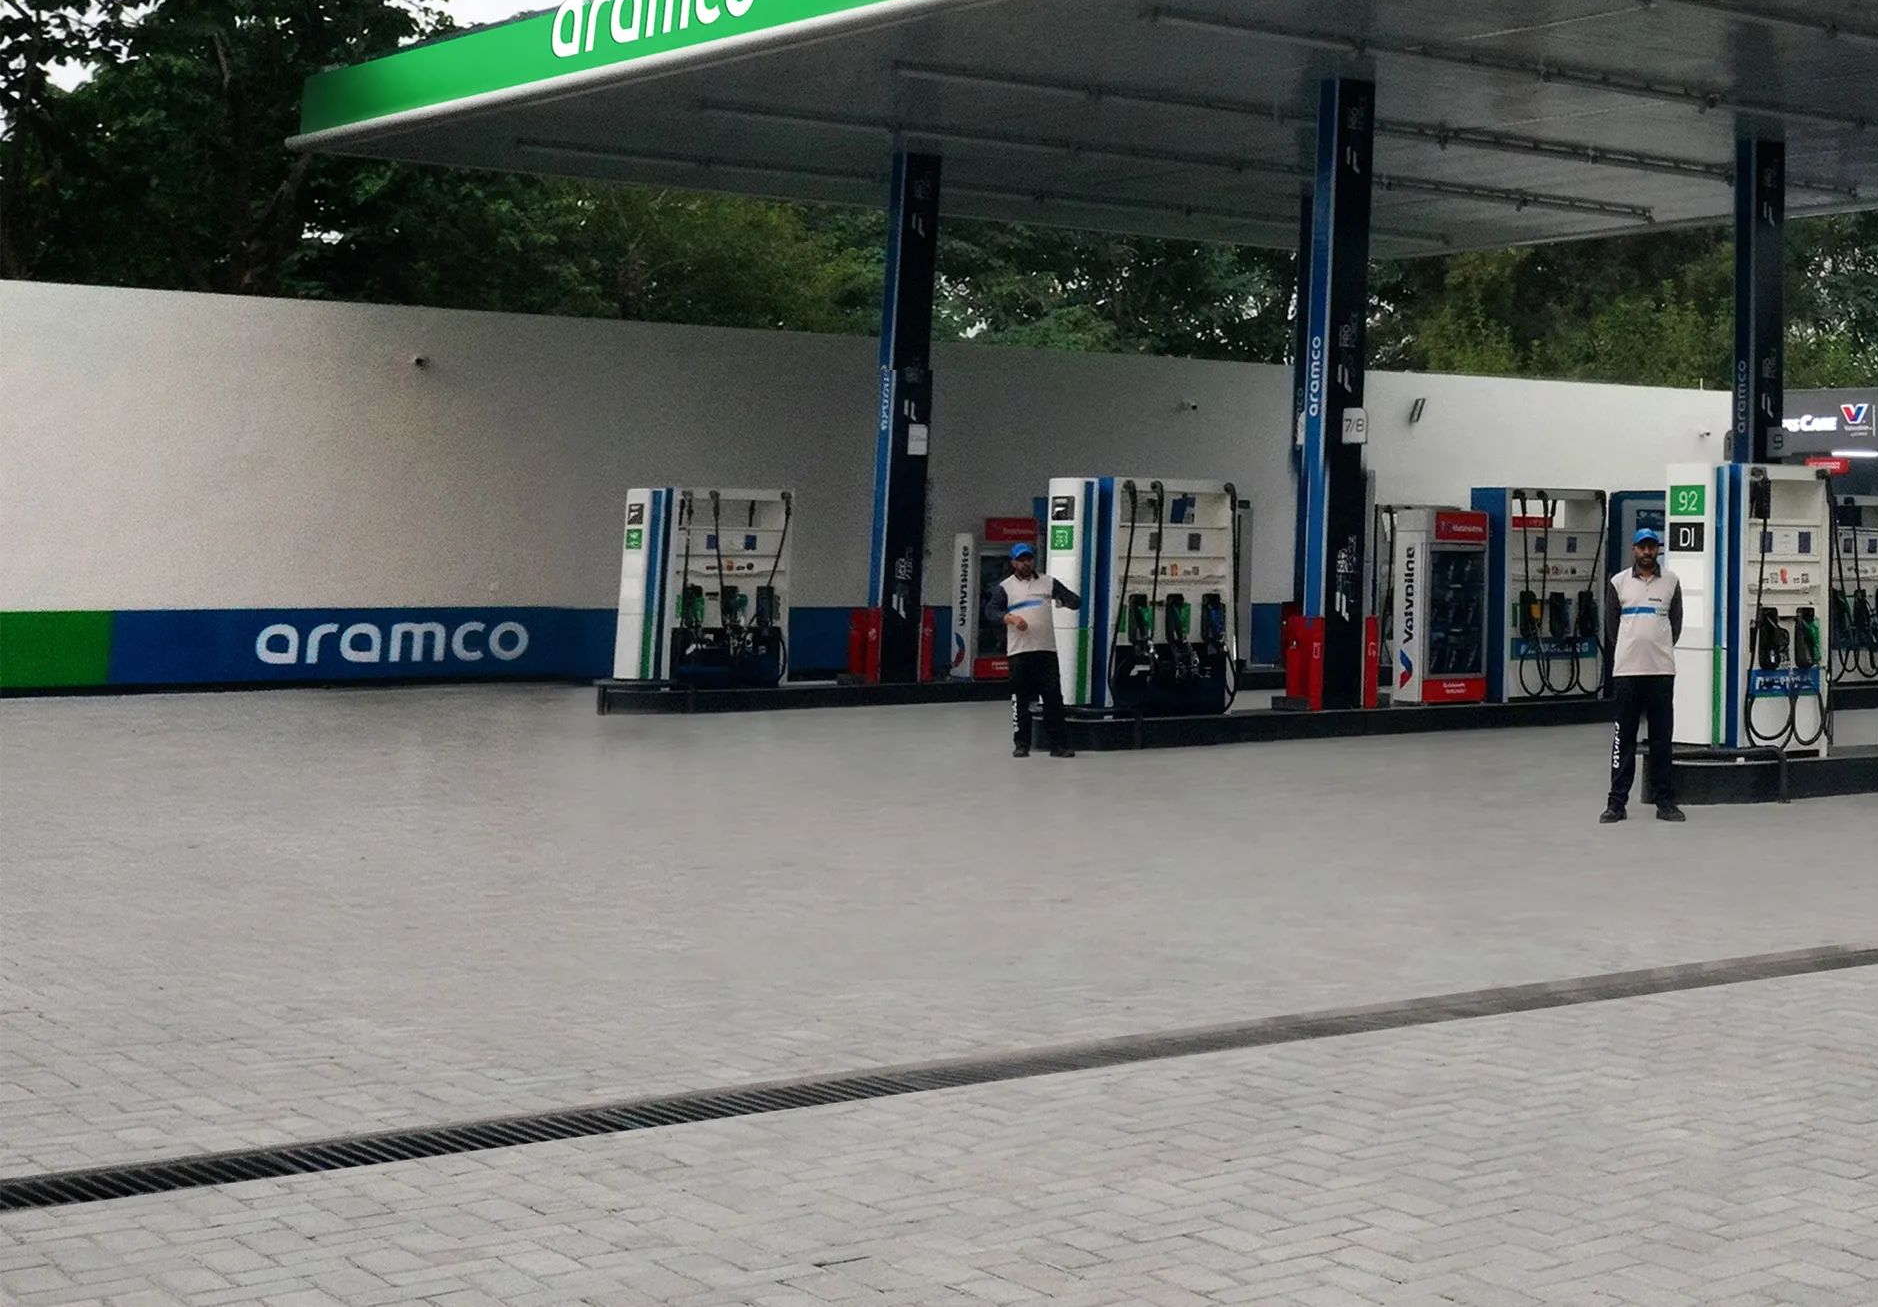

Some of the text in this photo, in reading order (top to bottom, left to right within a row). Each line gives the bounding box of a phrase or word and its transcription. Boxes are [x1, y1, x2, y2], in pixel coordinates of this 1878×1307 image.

[1309, 336, 1321, 417] aramco
[1737, 360, 1747, 434] aramco
[1678, 490, 1698, 512] 92
[1679, 527, 1695, 548] DI
[255, 620, 530, 666] aramco
